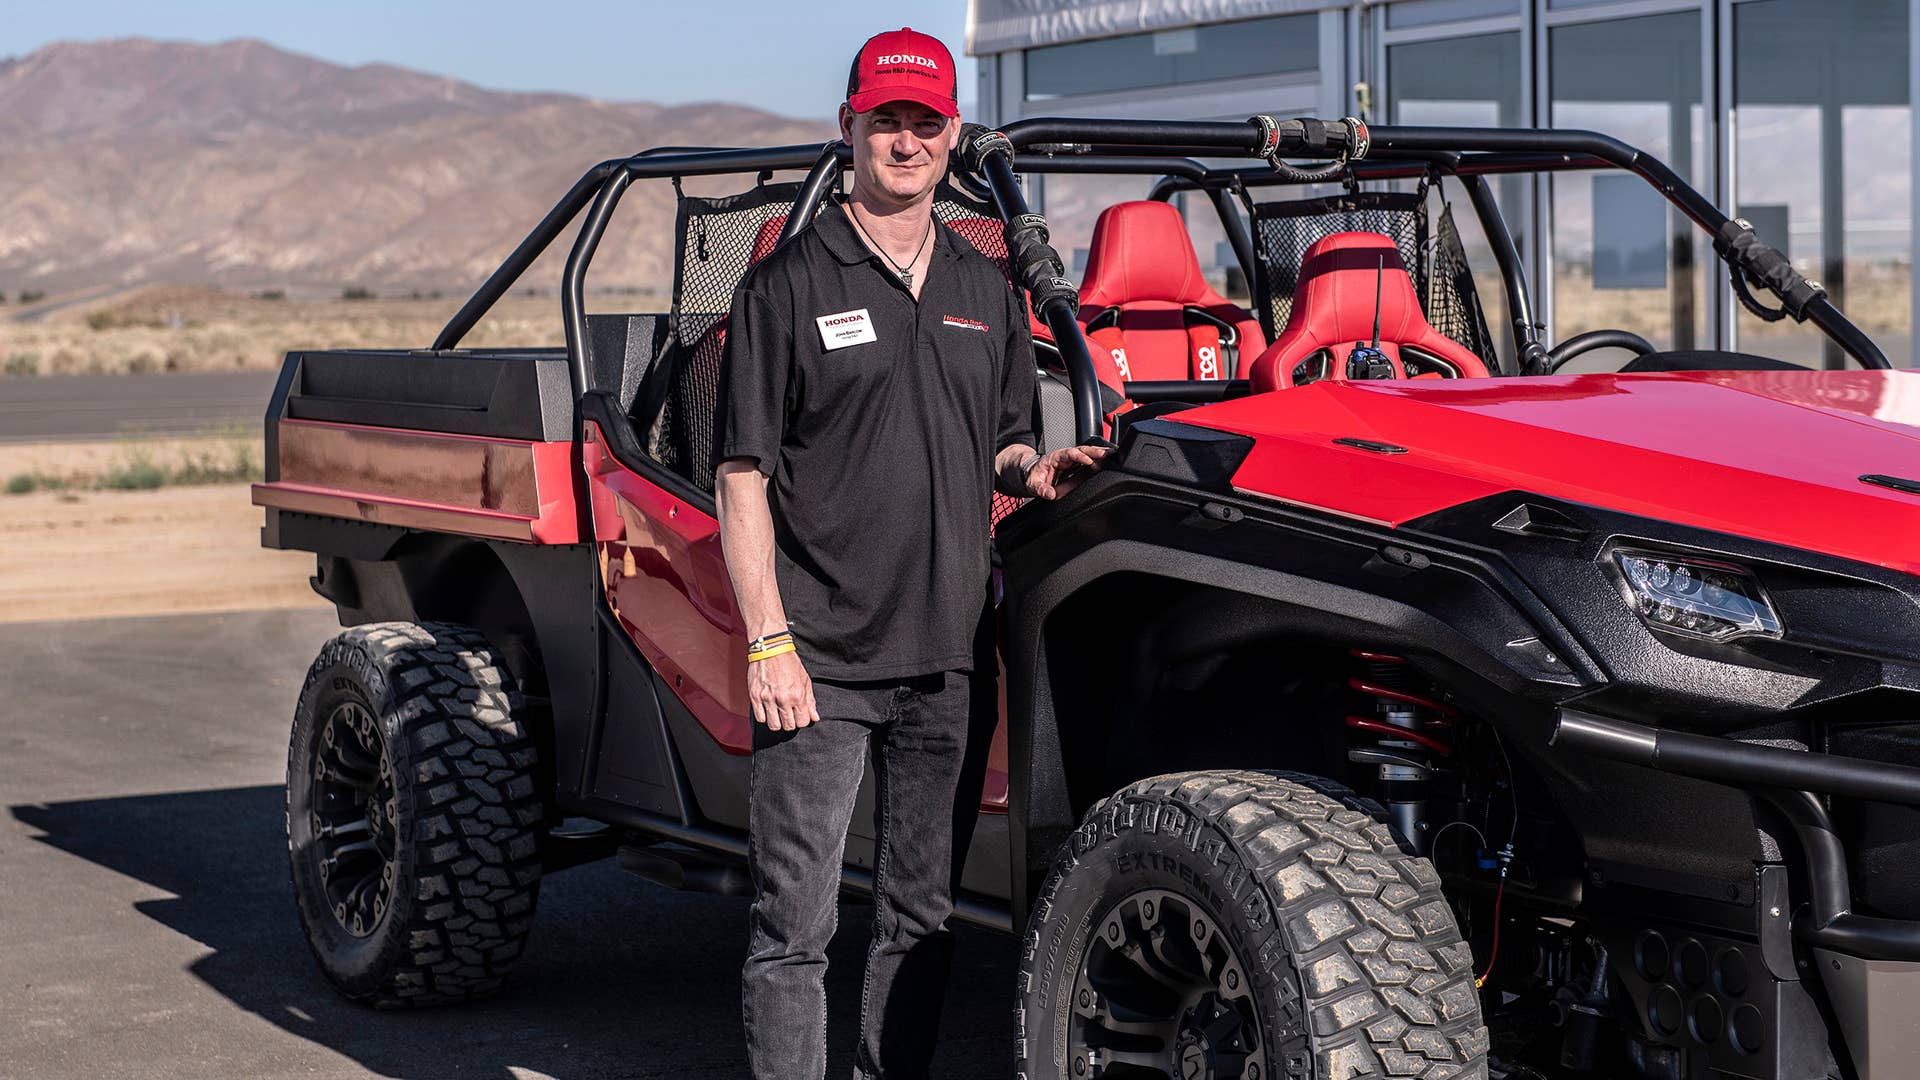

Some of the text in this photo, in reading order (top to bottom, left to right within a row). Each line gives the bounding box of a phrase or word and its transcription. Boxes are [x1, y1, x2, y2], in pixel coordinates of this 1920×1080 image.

[877, 54, 938, 69] HONDA
[825, 315, 864, 327] HONDA
[1117, 852, 1225, 916] EXTREME
